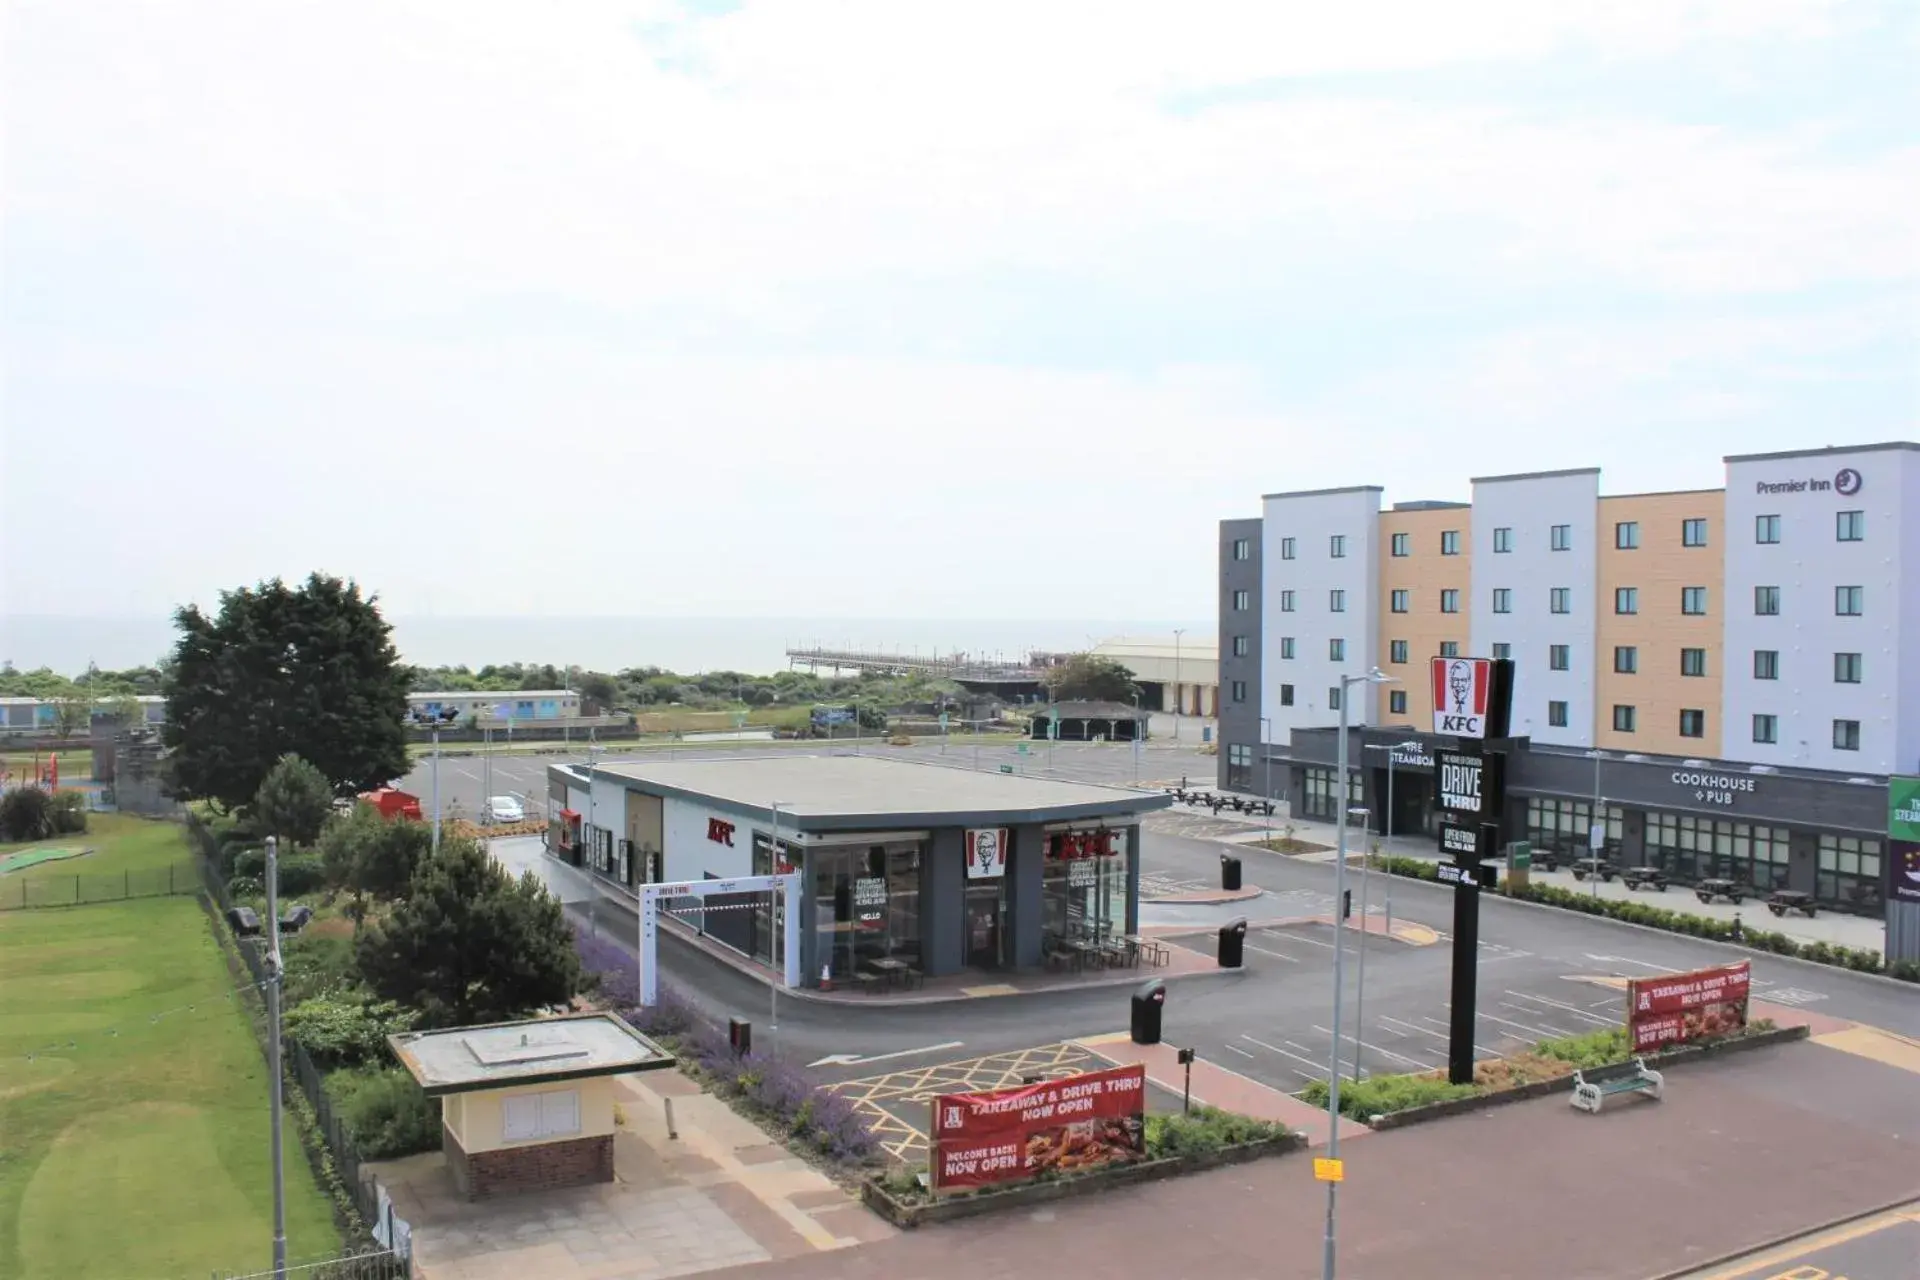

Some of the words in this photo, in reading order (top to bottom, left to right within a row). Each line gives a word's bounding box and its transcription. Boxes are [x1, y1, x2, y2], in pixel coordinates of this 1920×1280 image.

[1756, 479, 1806, 494] Premier
[1810, 478, 1831, 491] Inn
[1442, 715, 1478, 733] KFC
[1441, 764, 1482, 797] DRIVE
[1672, 772, 1755, 792] COOKHOUSE
[1441, 792, 1481, 812] THRU
[1706, 790, 1733, 804] PUB
[707, 817, 736, 848] KFC
[1701, 989, 1722, 1001] OPEN
[1657, 1027, 1678, 1040] OPEN
[971, 1092, 1045, 1116] TAKEAWAY
[1047, 1089, 1058, 1101] &
[1062, 1080, 1102, 1099] DRIVE
[1105, 1076, 1141, 1093] THRU
[1022, 1106, 1054, 1122] NOW
[1058, 1098, 1093, 1115] OPEN
[946, 1147, 988, 1162] WELCOME
[989, 1144, 1017, 1156] BACK!
[945, 1160, 977, 1176] NOW
[981, 1156, 1017, 1171] OPEN
